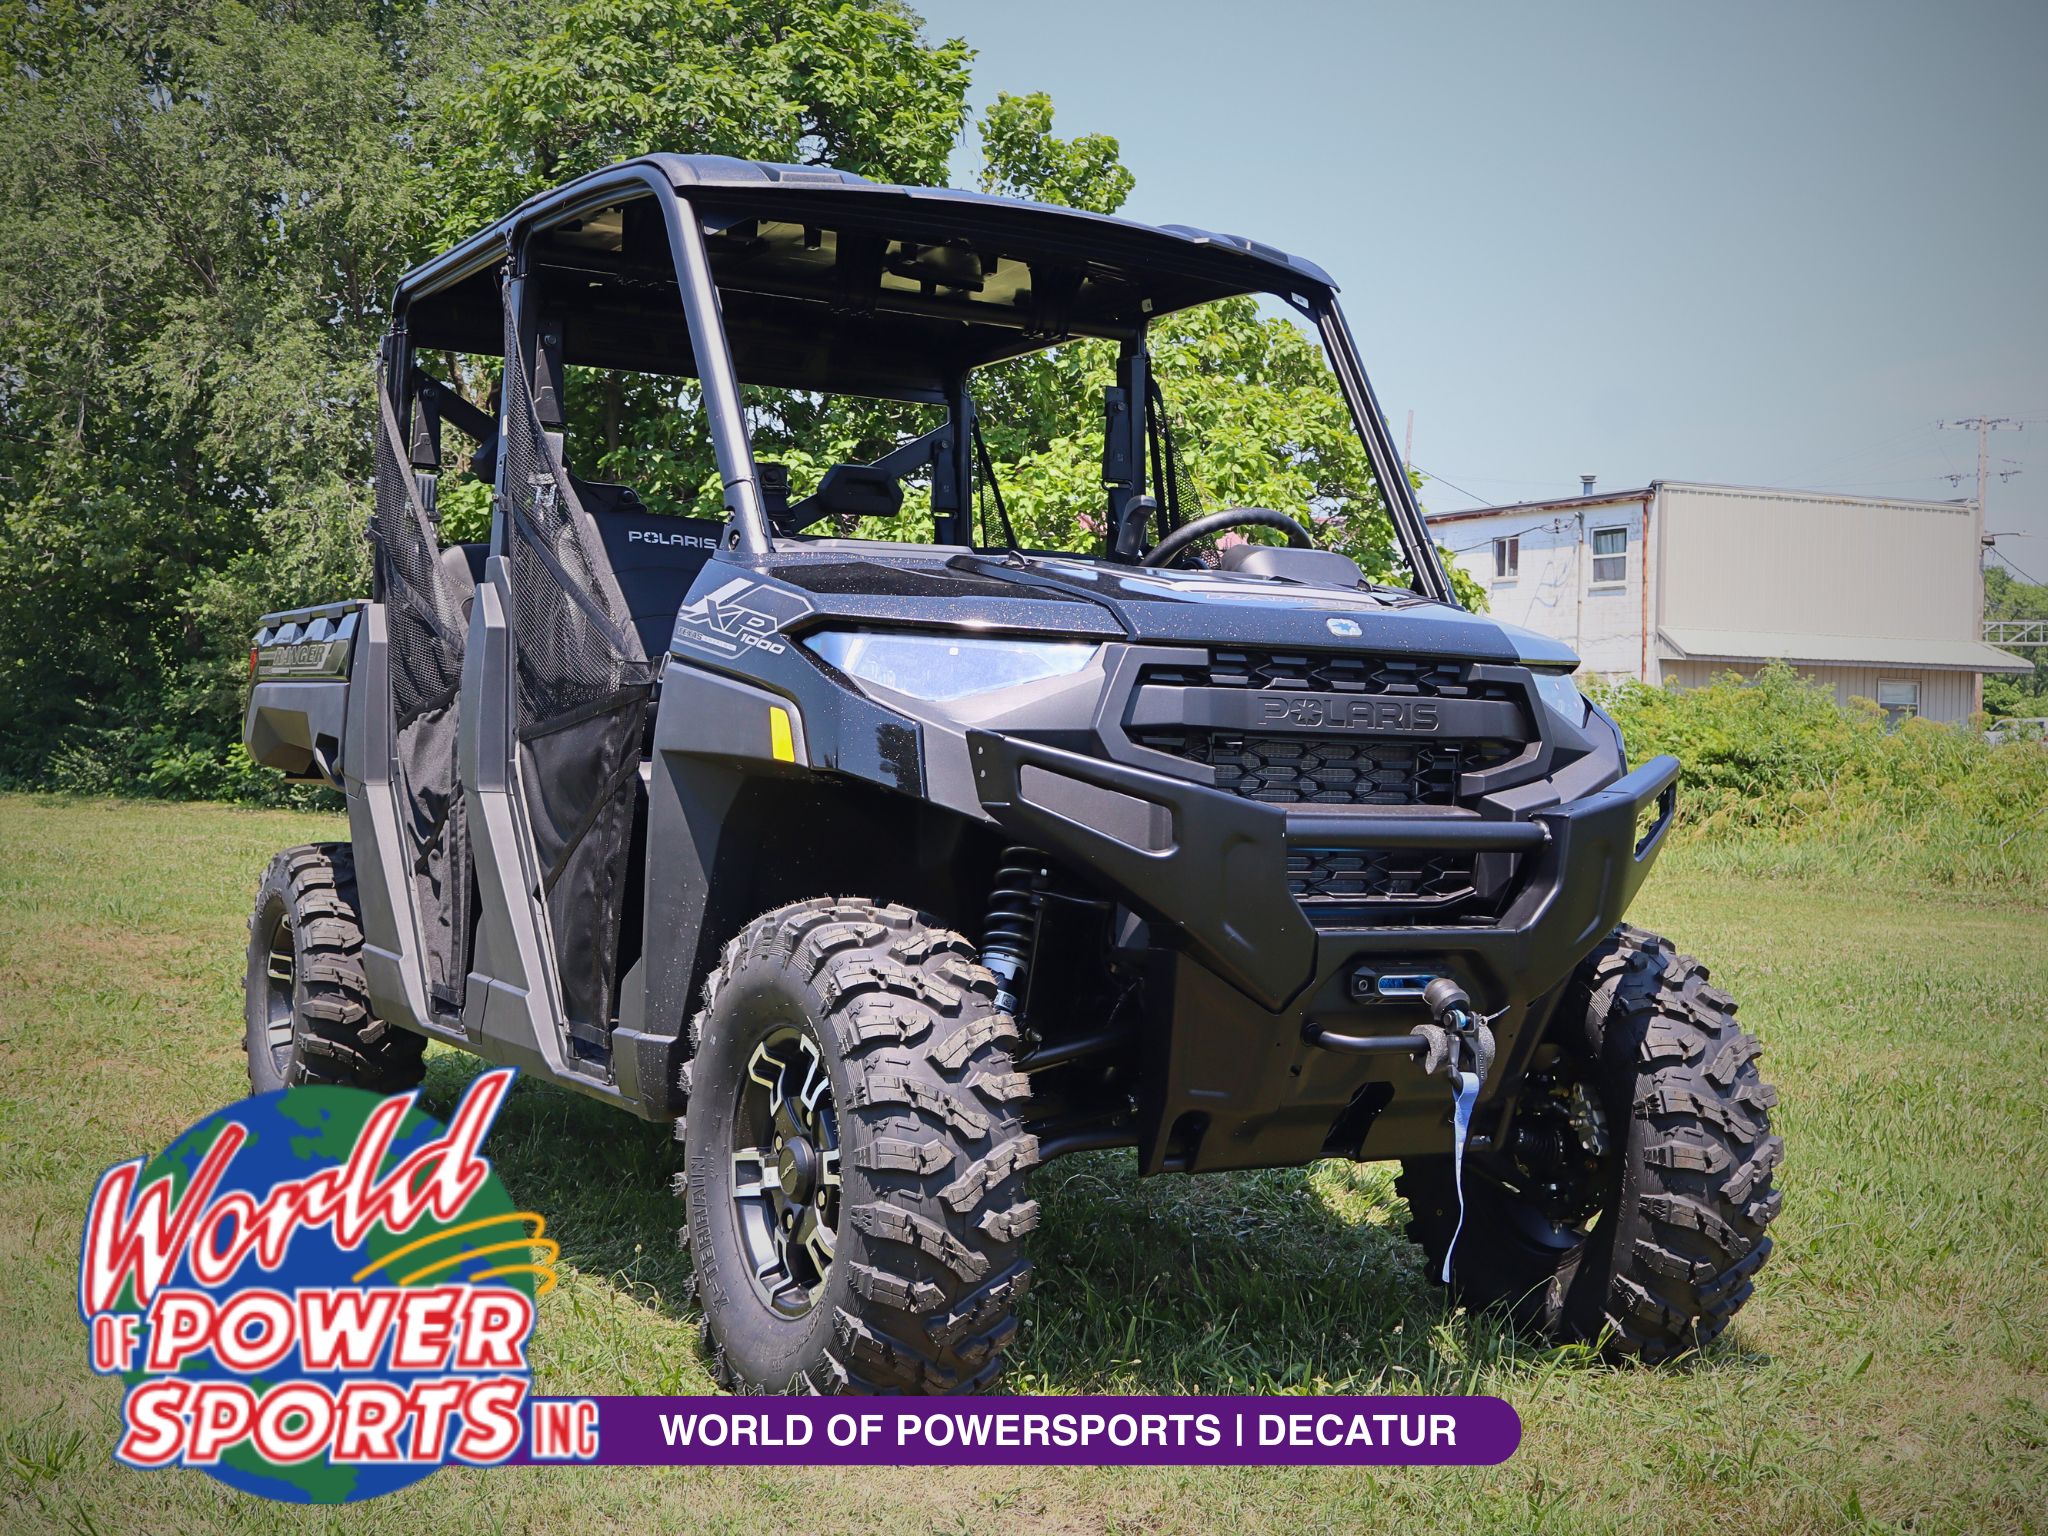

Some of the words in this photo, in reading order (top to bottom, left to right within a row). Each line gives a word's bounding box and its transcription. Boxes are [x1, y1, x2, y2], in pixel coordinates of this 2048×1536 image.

[628, 531, 717, 549] POLARIS
[679, 586, 780, 638] XP
[274, 644, 326, 665] RANGER
[740, 633, 786, 655] 1000
[1257, 696, 1439, 731] POLARIS
